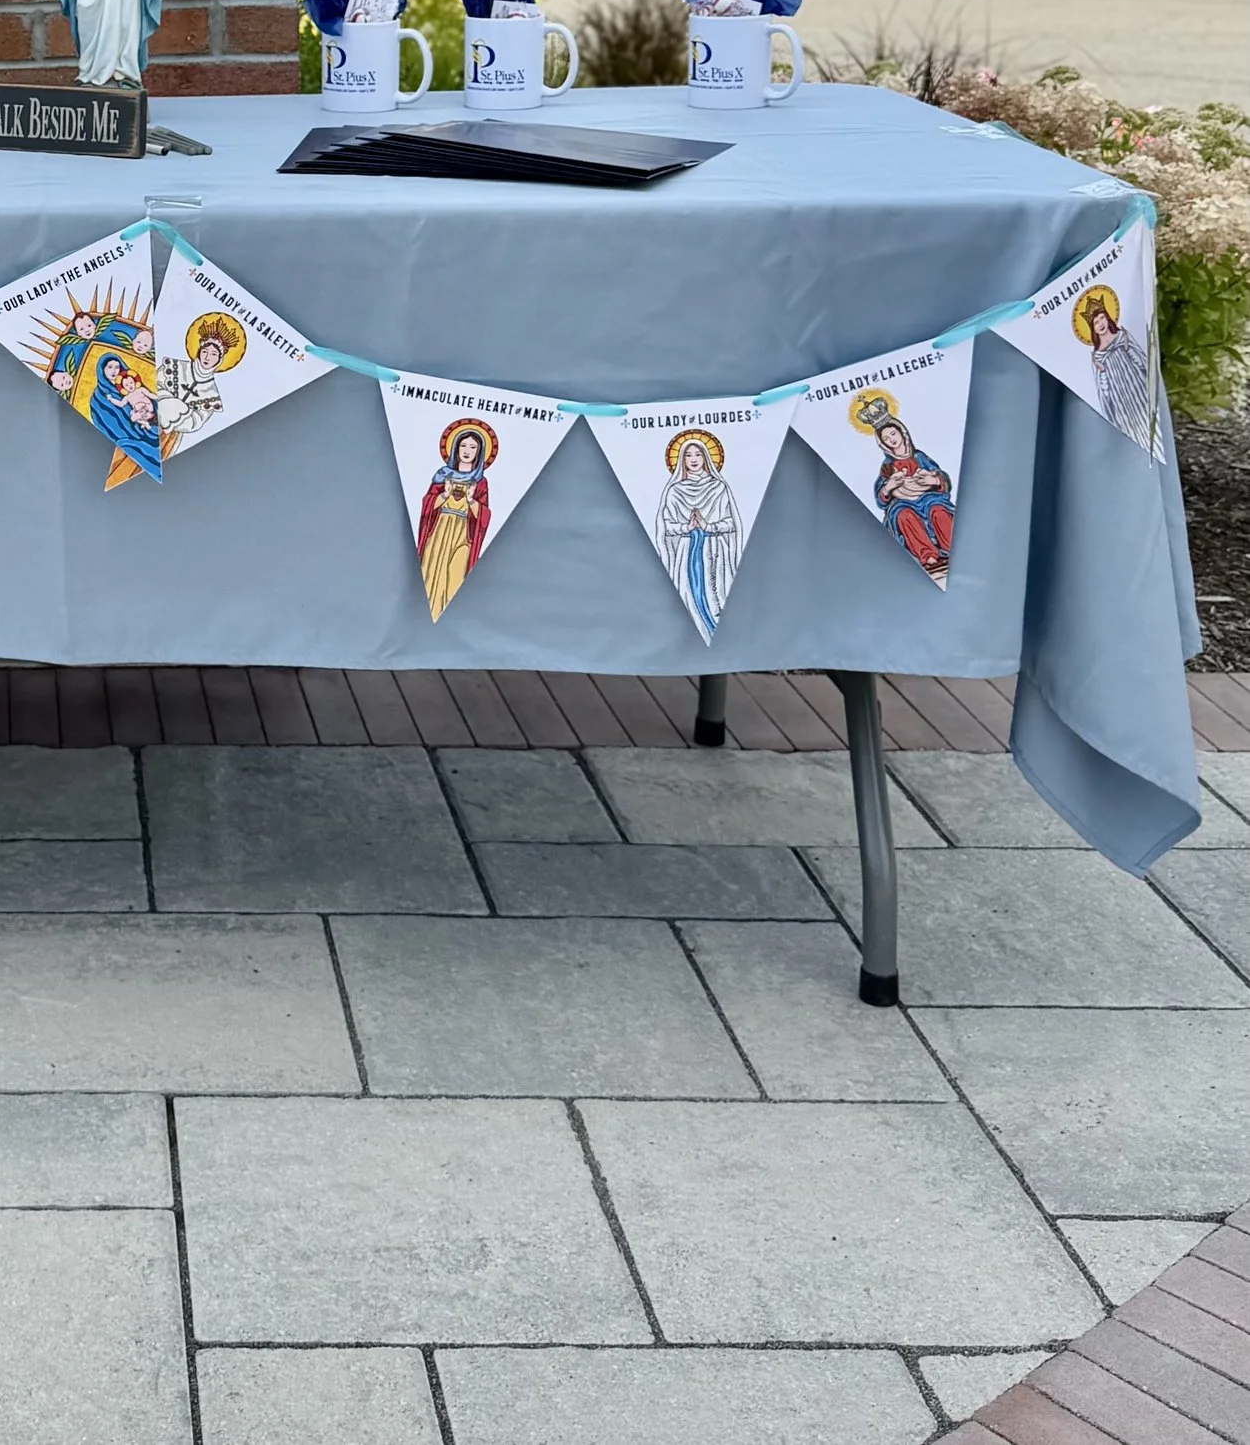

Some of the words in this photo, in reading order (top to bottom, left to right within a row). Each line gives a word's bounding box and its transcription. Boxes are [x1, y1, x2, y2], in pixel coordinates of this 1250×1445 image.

[346, 71, 367, 82] Pius
[368, 71, 376, 81] X
[494, 69, 516, 81] Pius
[517, 69, 525, 80] X
[711, 67, 734, 79] Pius
[735, 67, 743, 78] X
[2, 294, 26, 312] OUR
[26, 279, 54, 301] LADY
[60, 266, 82, 284] THE
[83, 246, 125, 274] ANGELS
[1040, 296, 1062, 315] OUR
[1060, 276, 1085, 301] LADY
[1089, 248, 1119, 279] KNOCK
[194, 272, 216, 293] OUR
[213, 287, 241, 312] LADY
[243, 311, 258, 327] LA
[256, 322, 299, 360] SALETTE
[815, 384, 839, 401] OUR
[840, 373, 870, 393] LADY
[880, 366, 895, 381] LA
[896, 353, 935, 375] LECHE
[401, 384, 475, 409] IMMACULATE
[477, 398, 515, 415] HEART
[523, 407, 554, 422] MARY
[632, 417, 654, 429] OUR
[657, 414, 687, 428] LADY
[698, 410, 751, 425] LOURDES
